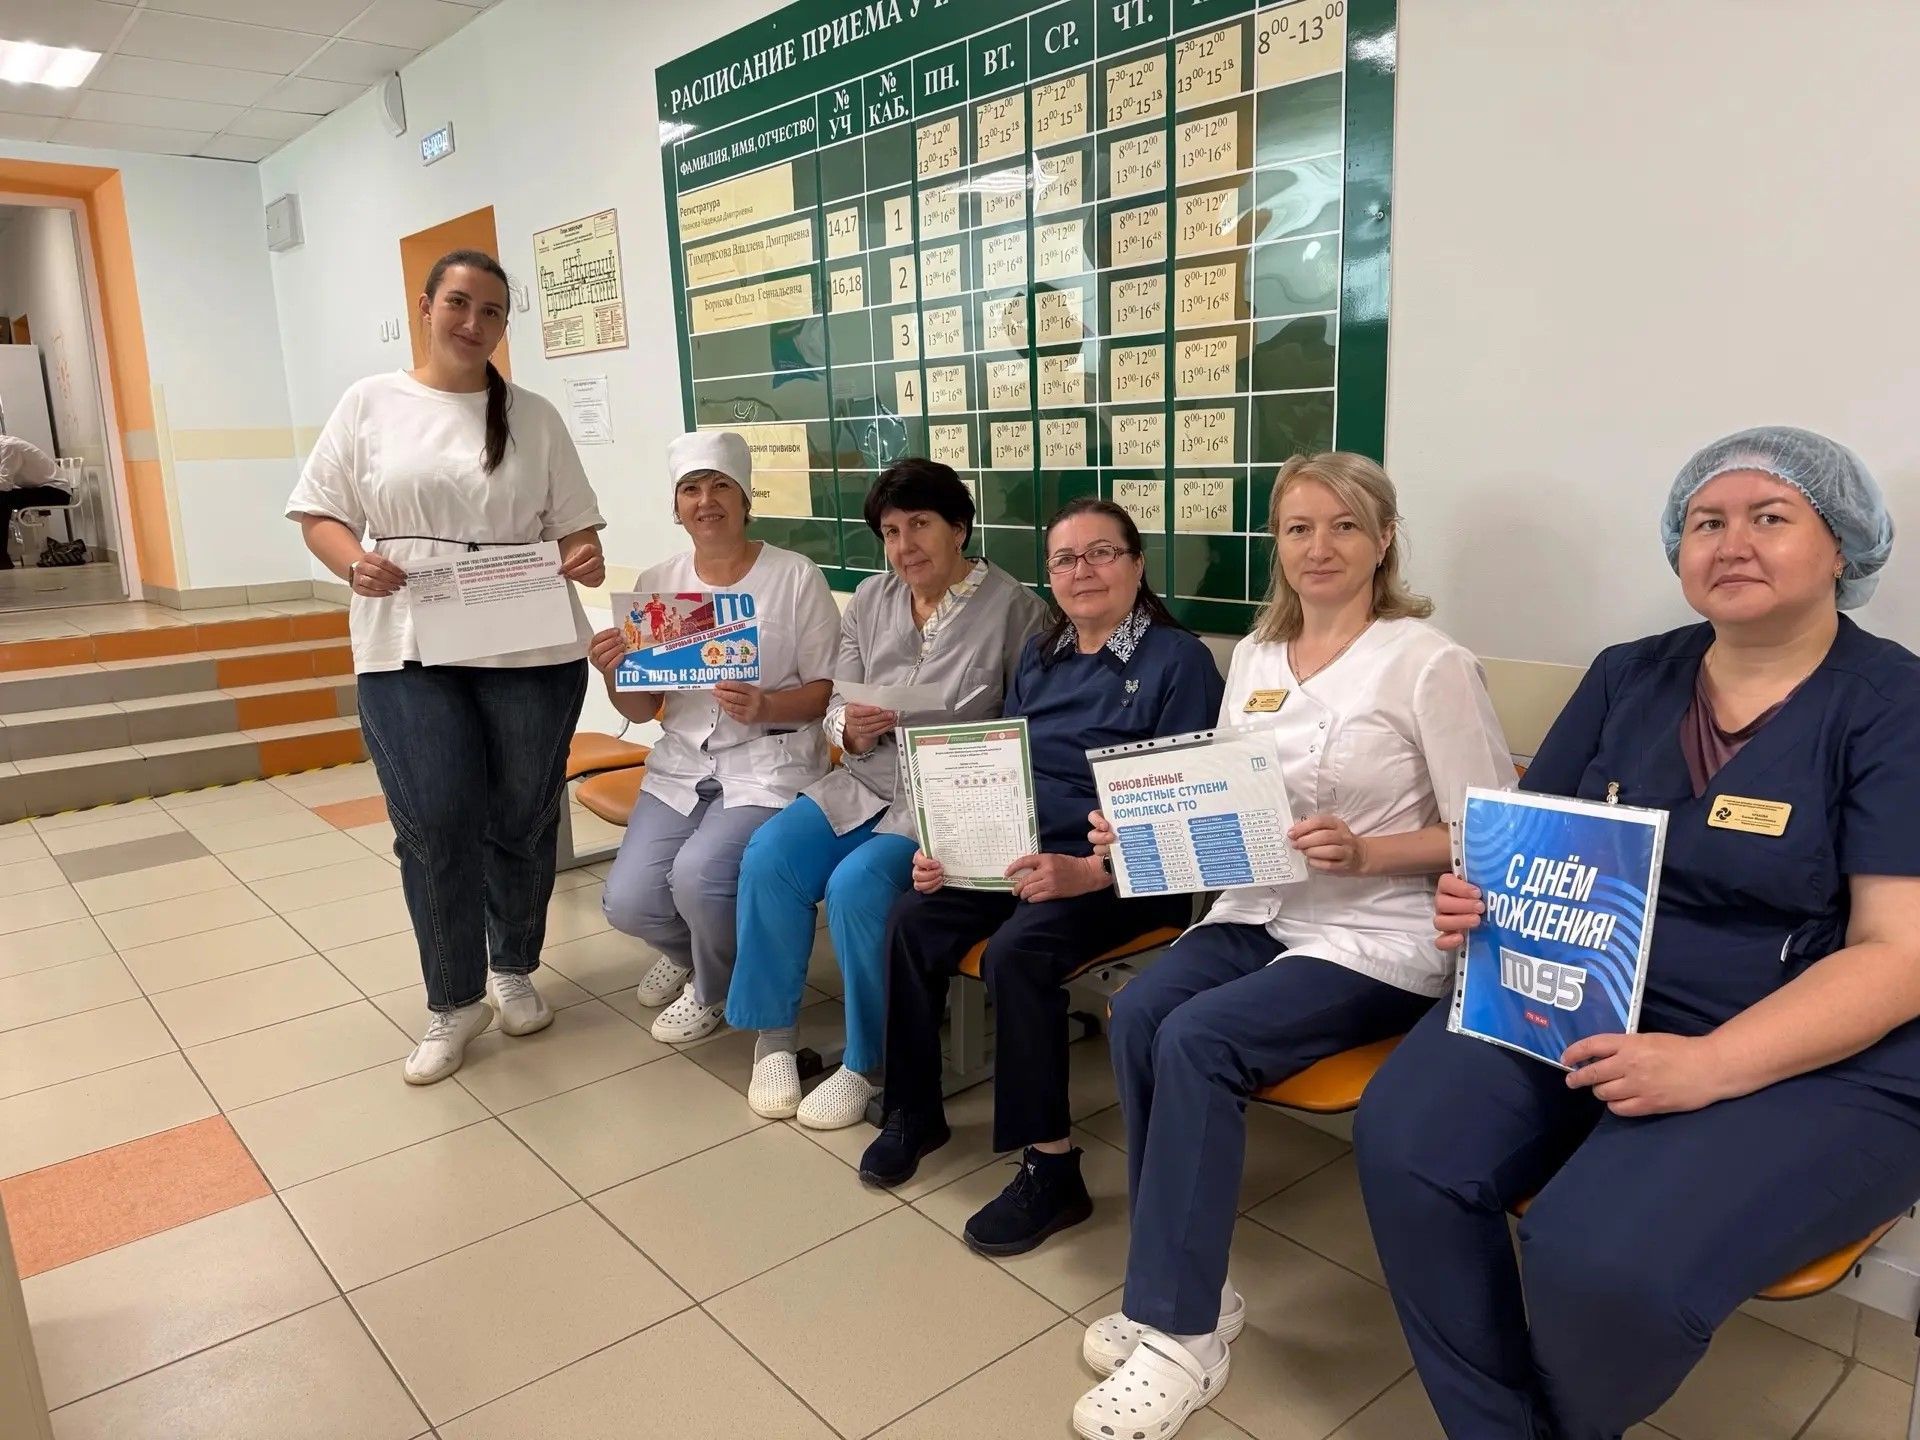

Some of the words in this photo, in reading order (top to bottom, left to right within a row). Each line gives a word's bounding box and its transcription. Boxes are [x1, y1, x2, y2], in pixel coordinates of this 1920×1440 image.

[1113, 0, 1154, 31] ЧТ.
[1044, 21, 1080, 55] СР.
[670, 39, 796, 114] РАСПИСАНИЕ
[802, 3, 902, 62] ПРИЕМА
[983, 43, 1015, 76] ВТ.
[879, 71, 896, 96] №
[924, 64, 960, 97] ПН.
[833, 90, 850, 113] №
[868, 95, 910, 127] КАБ.
[829, 112, 851, 140] УЧ
[680, 149, 731, 176] ФАМИЛИЯ,
[732, 138, 757, 161] ИМЯ,
[757, 116, 815, 150] ОТЧЕСТВО
[680, 199, 720, 218] Регистратура
[894, 208, 903, 231] 1
[827, 214, 857, 238] 14,17
[765, 228, 810, 249] Дмитриевна
[832, 274, 862, 296] 16,18
[898, 266, 908, 289] 2
[734, 290, 755, 305] Ольга
[757, 282, 803, 300] Геннадьевна
[901, 324, 910, 346] 3
[904, 380, 914, 401] 4
[751, 487, 770, 499] бинет
[714, 593, 756, 625] ГТО
[619, 670, 640, 683] ГТО
[649, 669, 678, 683] ПУТЬ
[680, 669, 688, 682] К
[690, 665, 759, 683] ЗДОРОВЬЮ!
[1108, 772, 1184, 792] ОБНОВЛЁННЫЕ
[1111, 790, 1176, 806] ВОЗРАСТНЫЕ
[1178, 780, 1228, 797] СТУПЕНИ
[1114, 805, 1175, 820] КОМПЛЕКСА
[1177, 801, 1198, 812] ГТО
[1505, 854, 1525, 889] С
[1520, 854, 1598, 903] ДНЁМ
[1487, 891, 1618, 951] РОЖДЕНИЯ!
